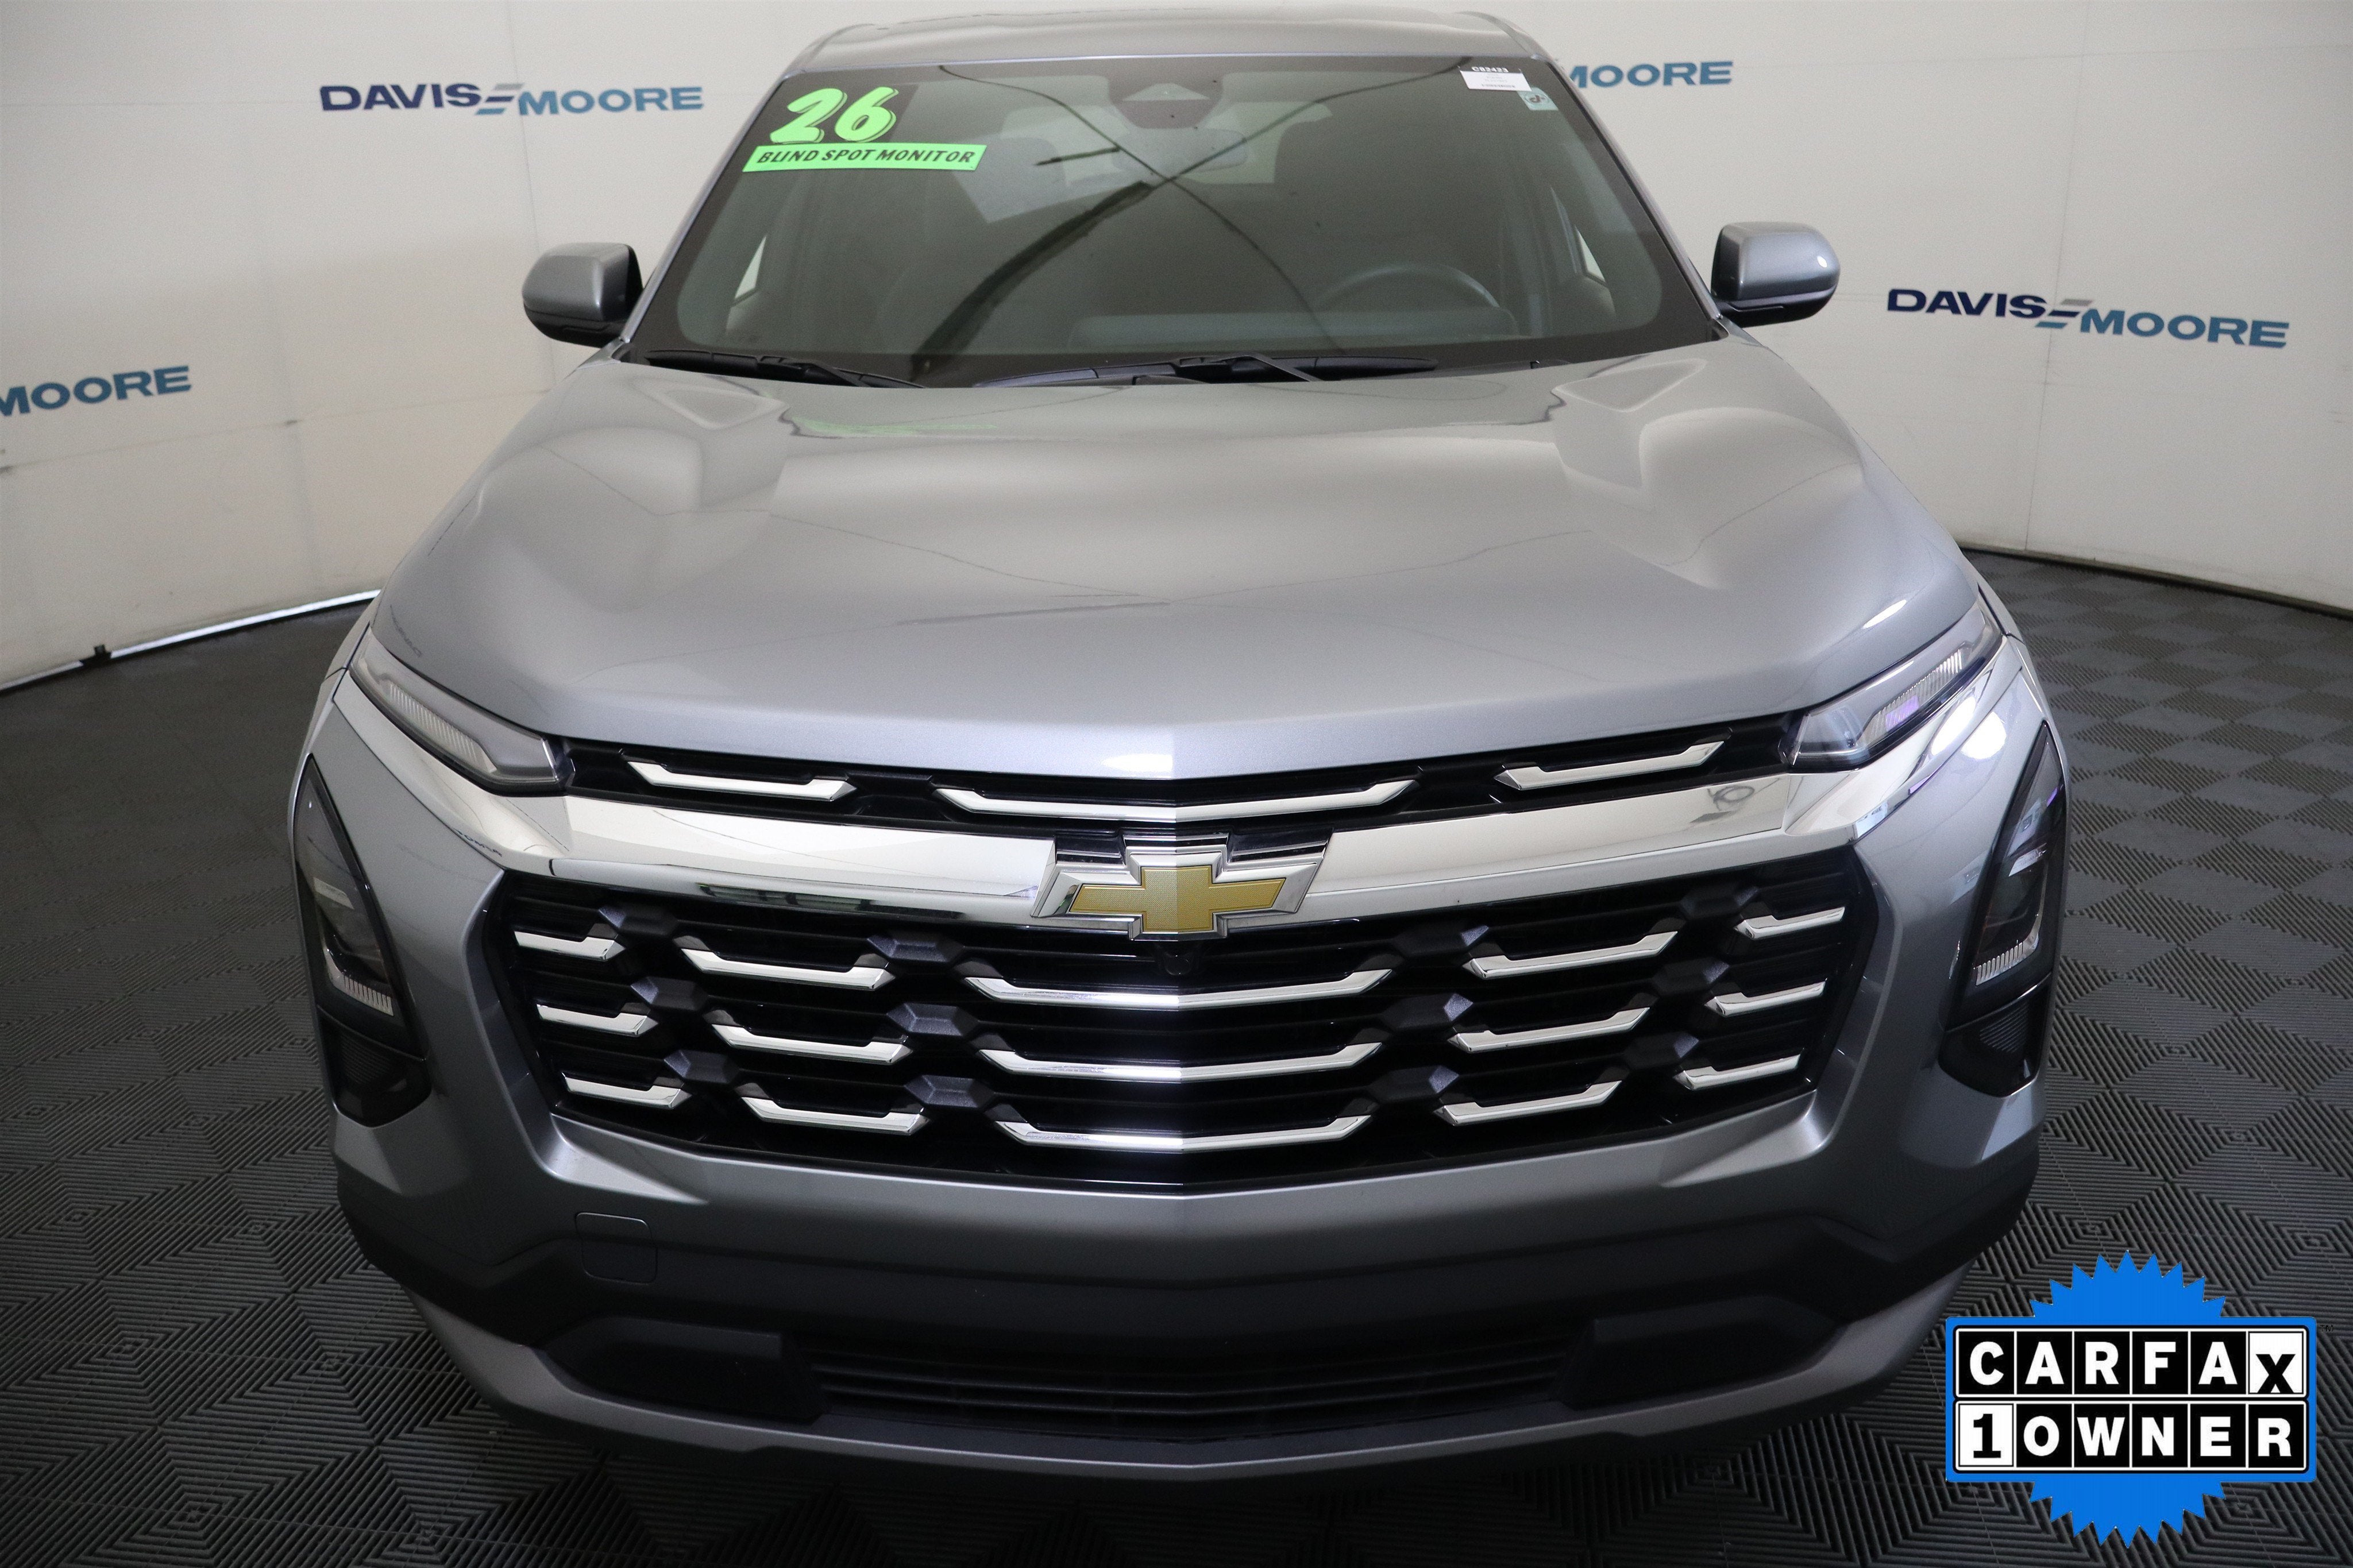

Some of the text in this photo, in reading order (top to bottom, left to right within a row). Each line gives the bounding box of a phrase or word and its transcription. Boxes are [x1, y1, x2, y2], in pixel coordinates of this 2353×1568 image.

[319, 83, 704, 115] DAVIS MOORE
[769, 86, 899, 144] 26
[756, 149, 975, 163] BLIND SPOT MONITOR
[1887, 288, 2290, 349] DAVIS MOORE
